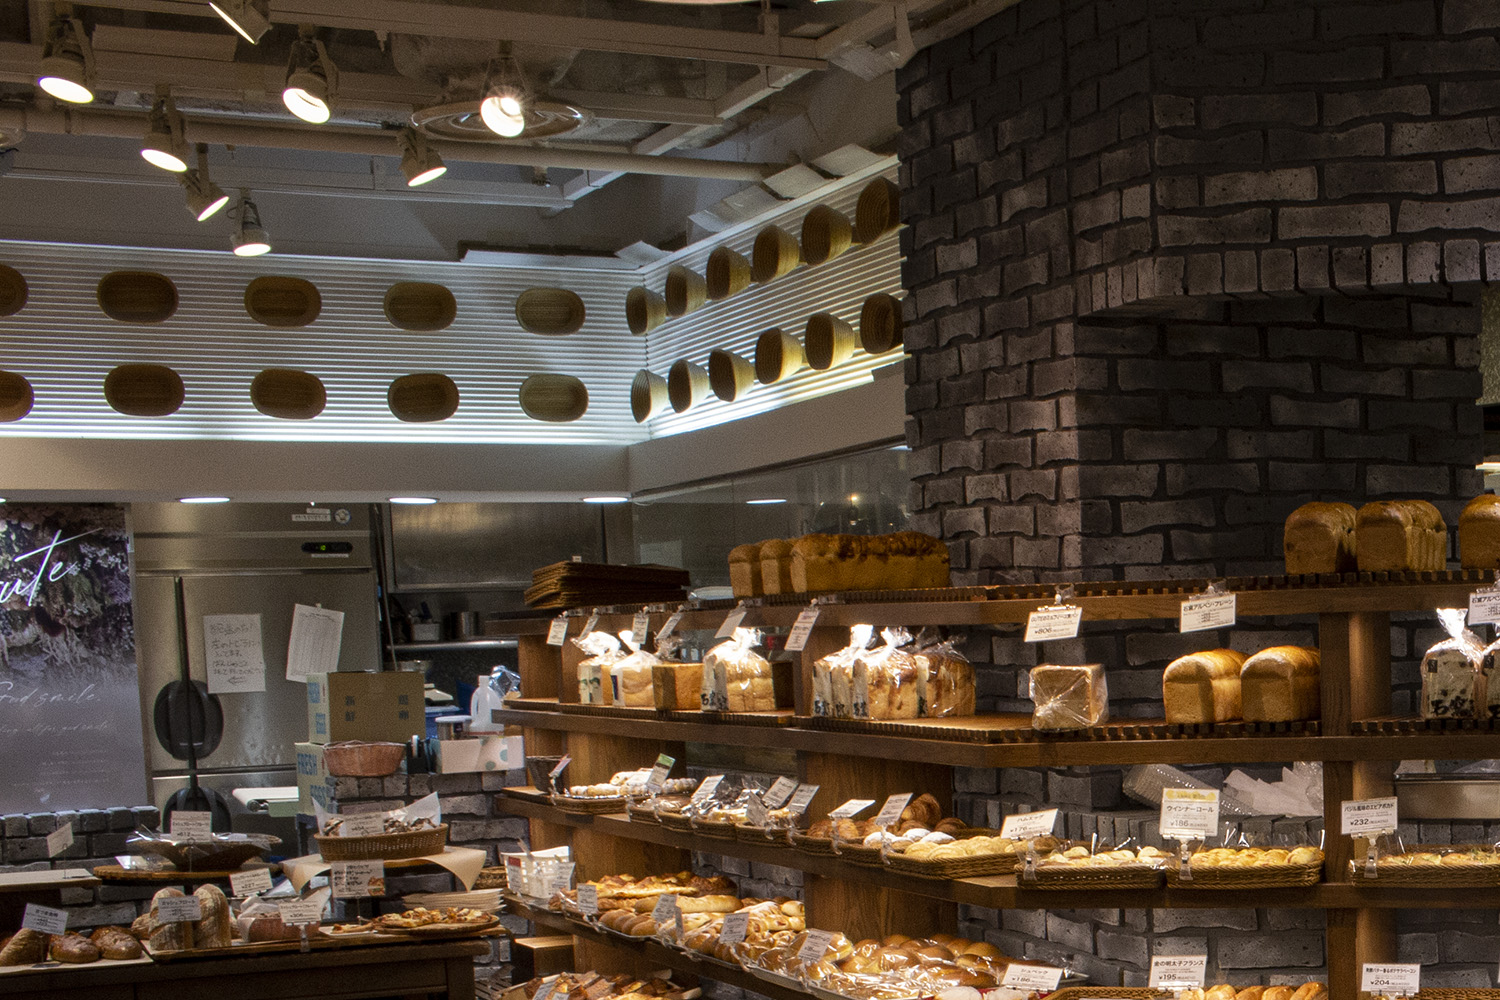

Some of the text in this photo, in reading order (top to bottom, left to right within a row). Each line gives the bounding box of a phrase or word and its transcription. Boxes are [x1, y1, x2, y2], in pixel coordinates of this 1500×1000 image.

[1166, 805, 1214, 813] ウインナーロール
[1350, 818, 1369, 826] ¥232
